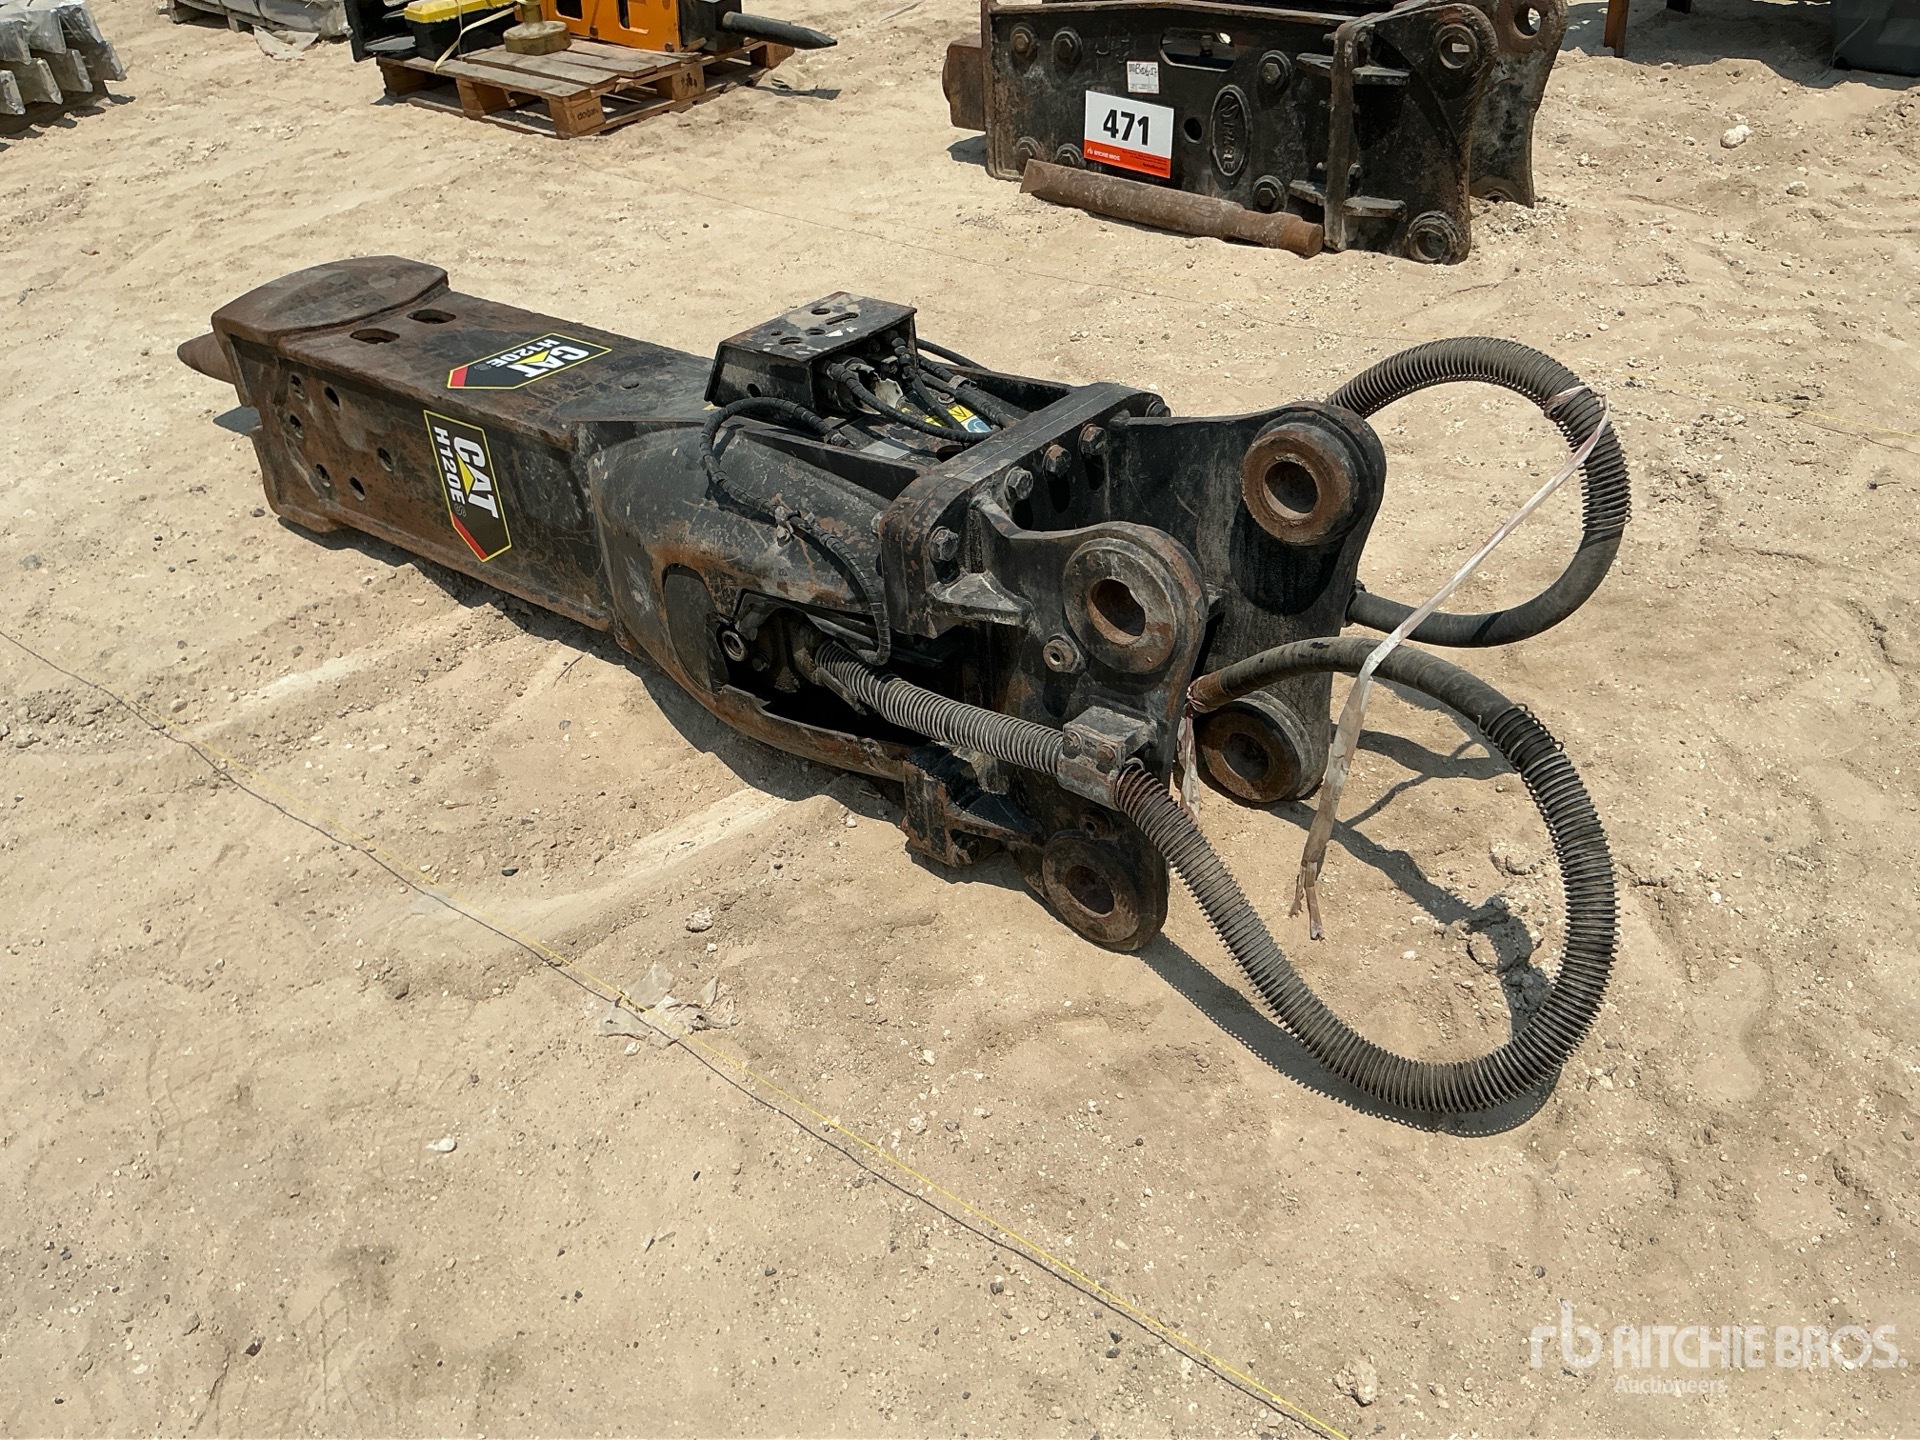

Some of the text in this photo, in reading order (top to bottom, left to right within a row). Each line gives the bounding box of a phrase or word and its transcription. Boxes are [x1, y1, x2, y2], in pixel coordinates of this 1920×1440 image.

[1103, 109, 1150, 146] 471
[506, 345, 590, 378] CAT
[454, 436, 499, 518] CAT
